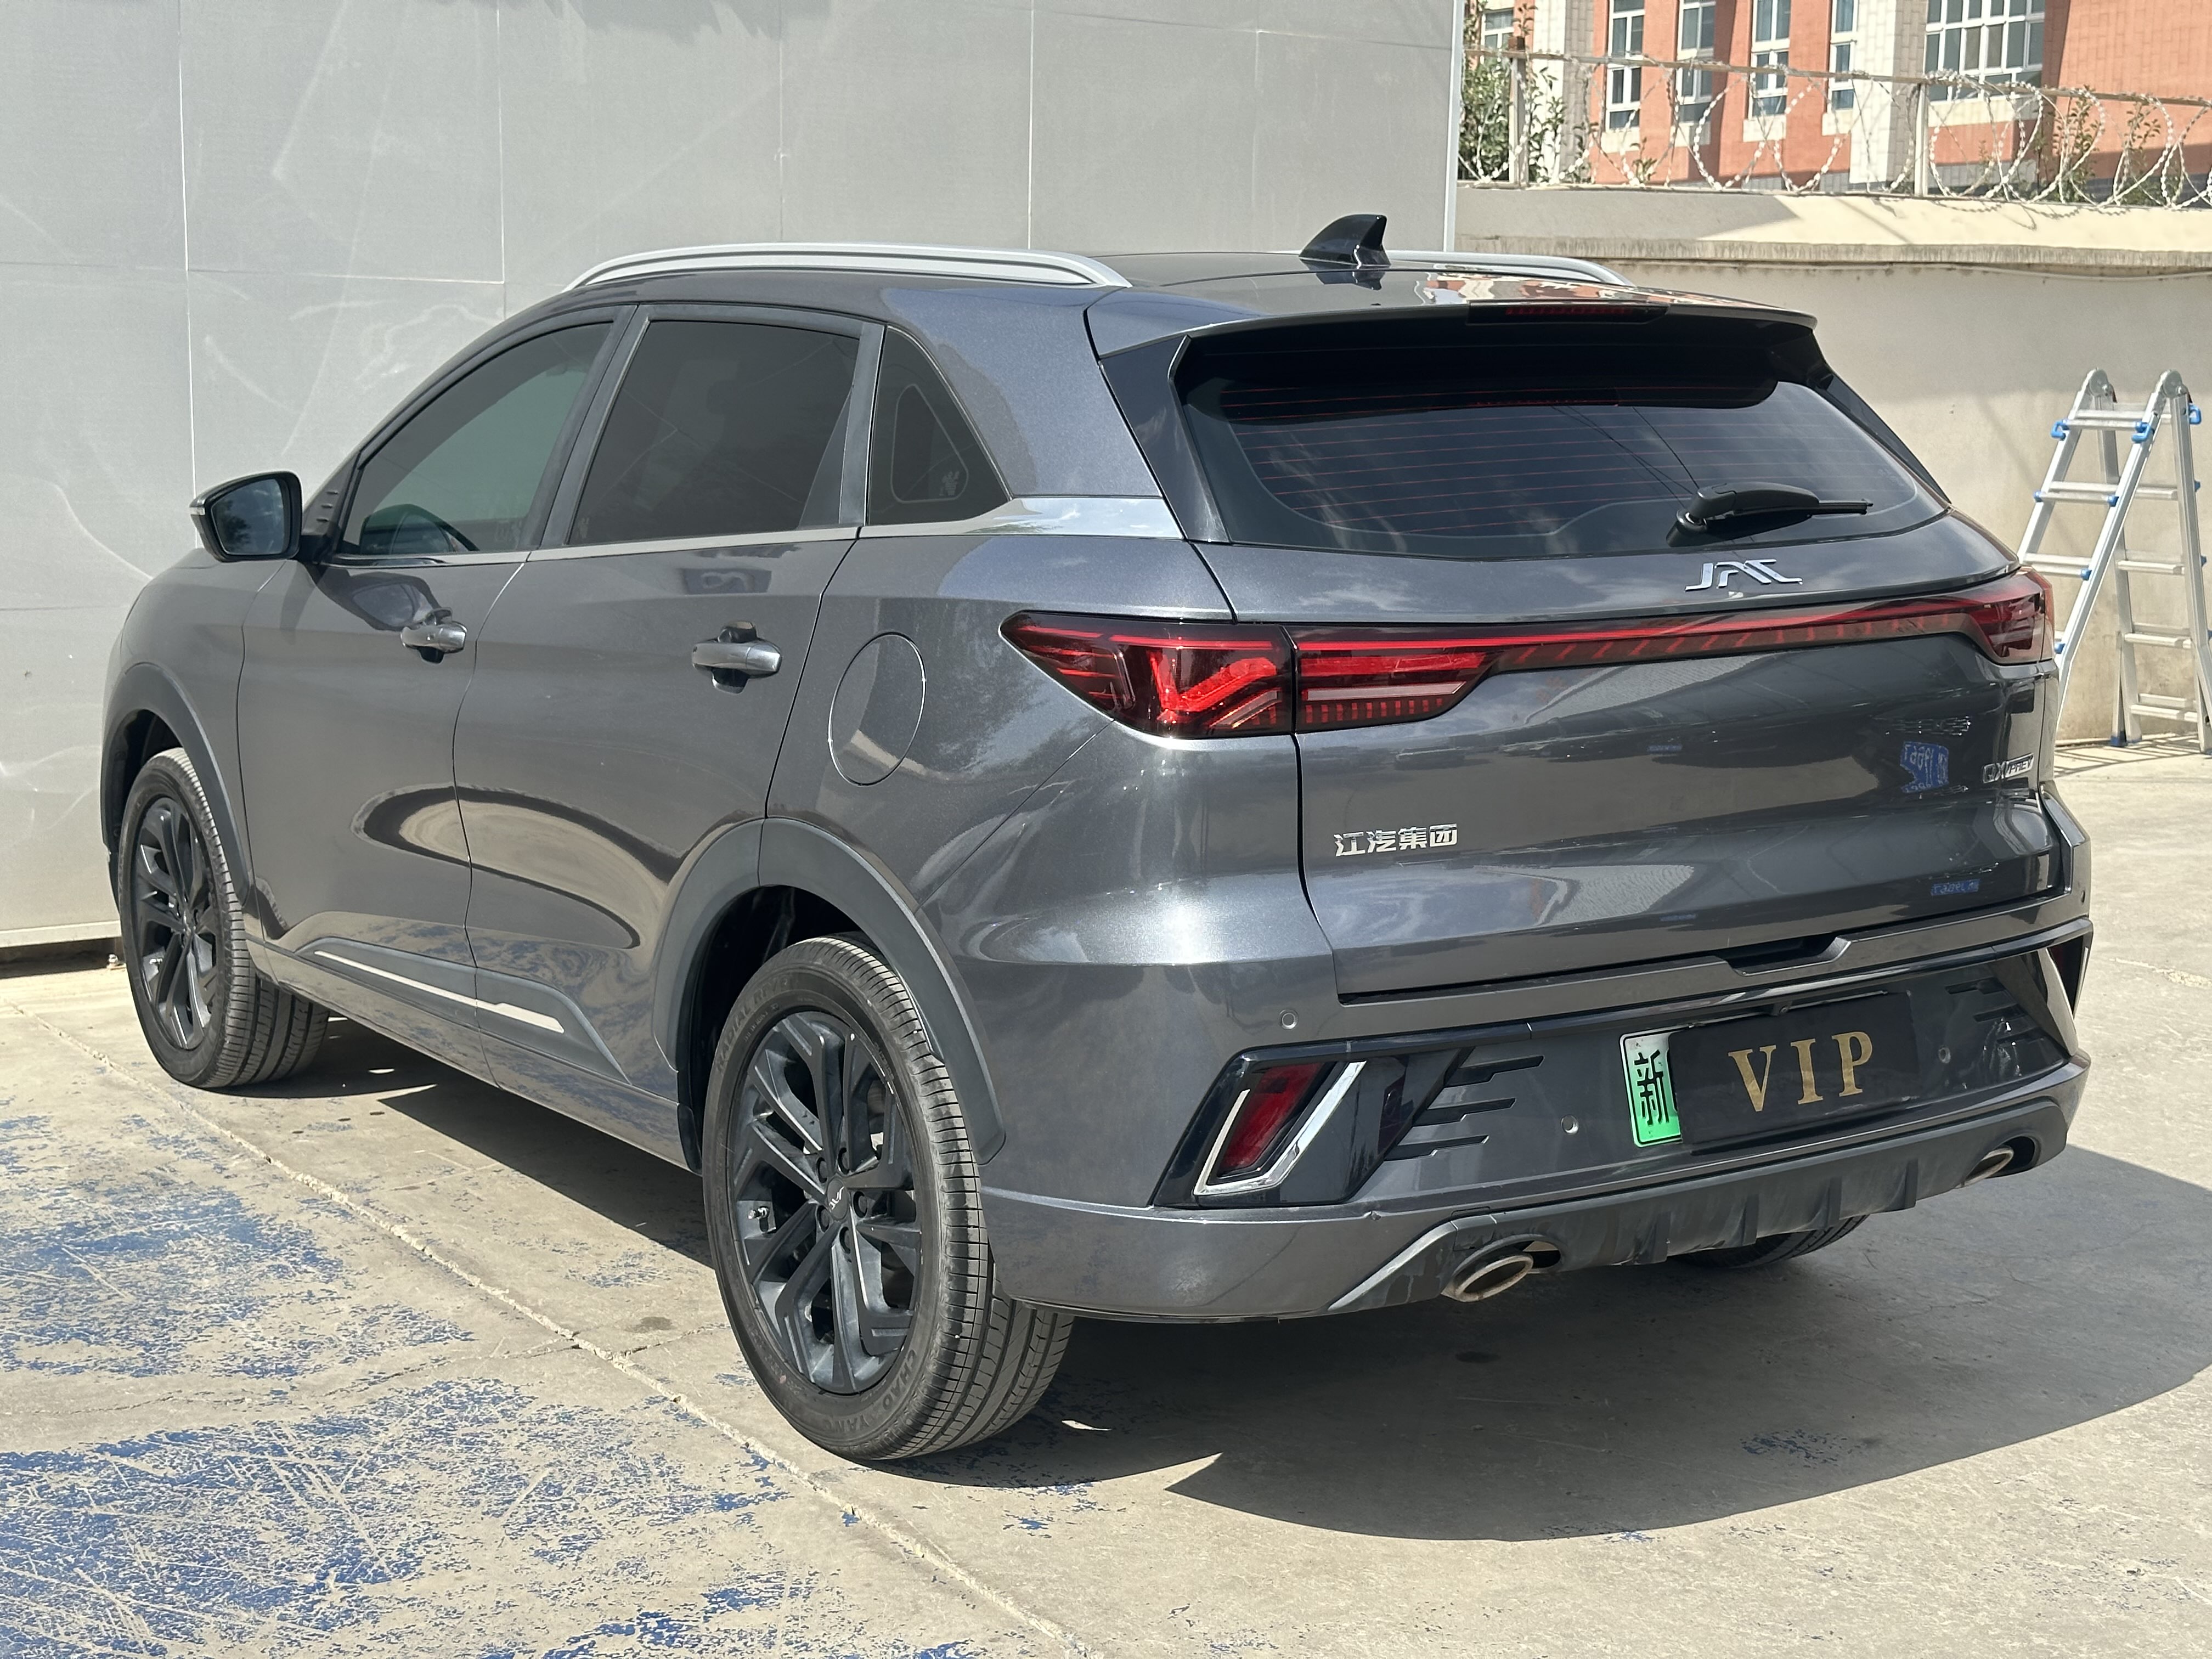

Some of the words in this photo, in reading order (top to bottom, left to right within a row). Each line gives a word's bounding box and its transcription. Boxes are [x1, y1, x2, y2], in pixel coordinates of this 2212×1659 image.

[1684, 558, 1803, 591] JAC
[1334, 823, 1458, 856] 江汽集团
[1633, 1049, 1670, 1126] 新
[1728, 1031, 1874, 1113] VIP
